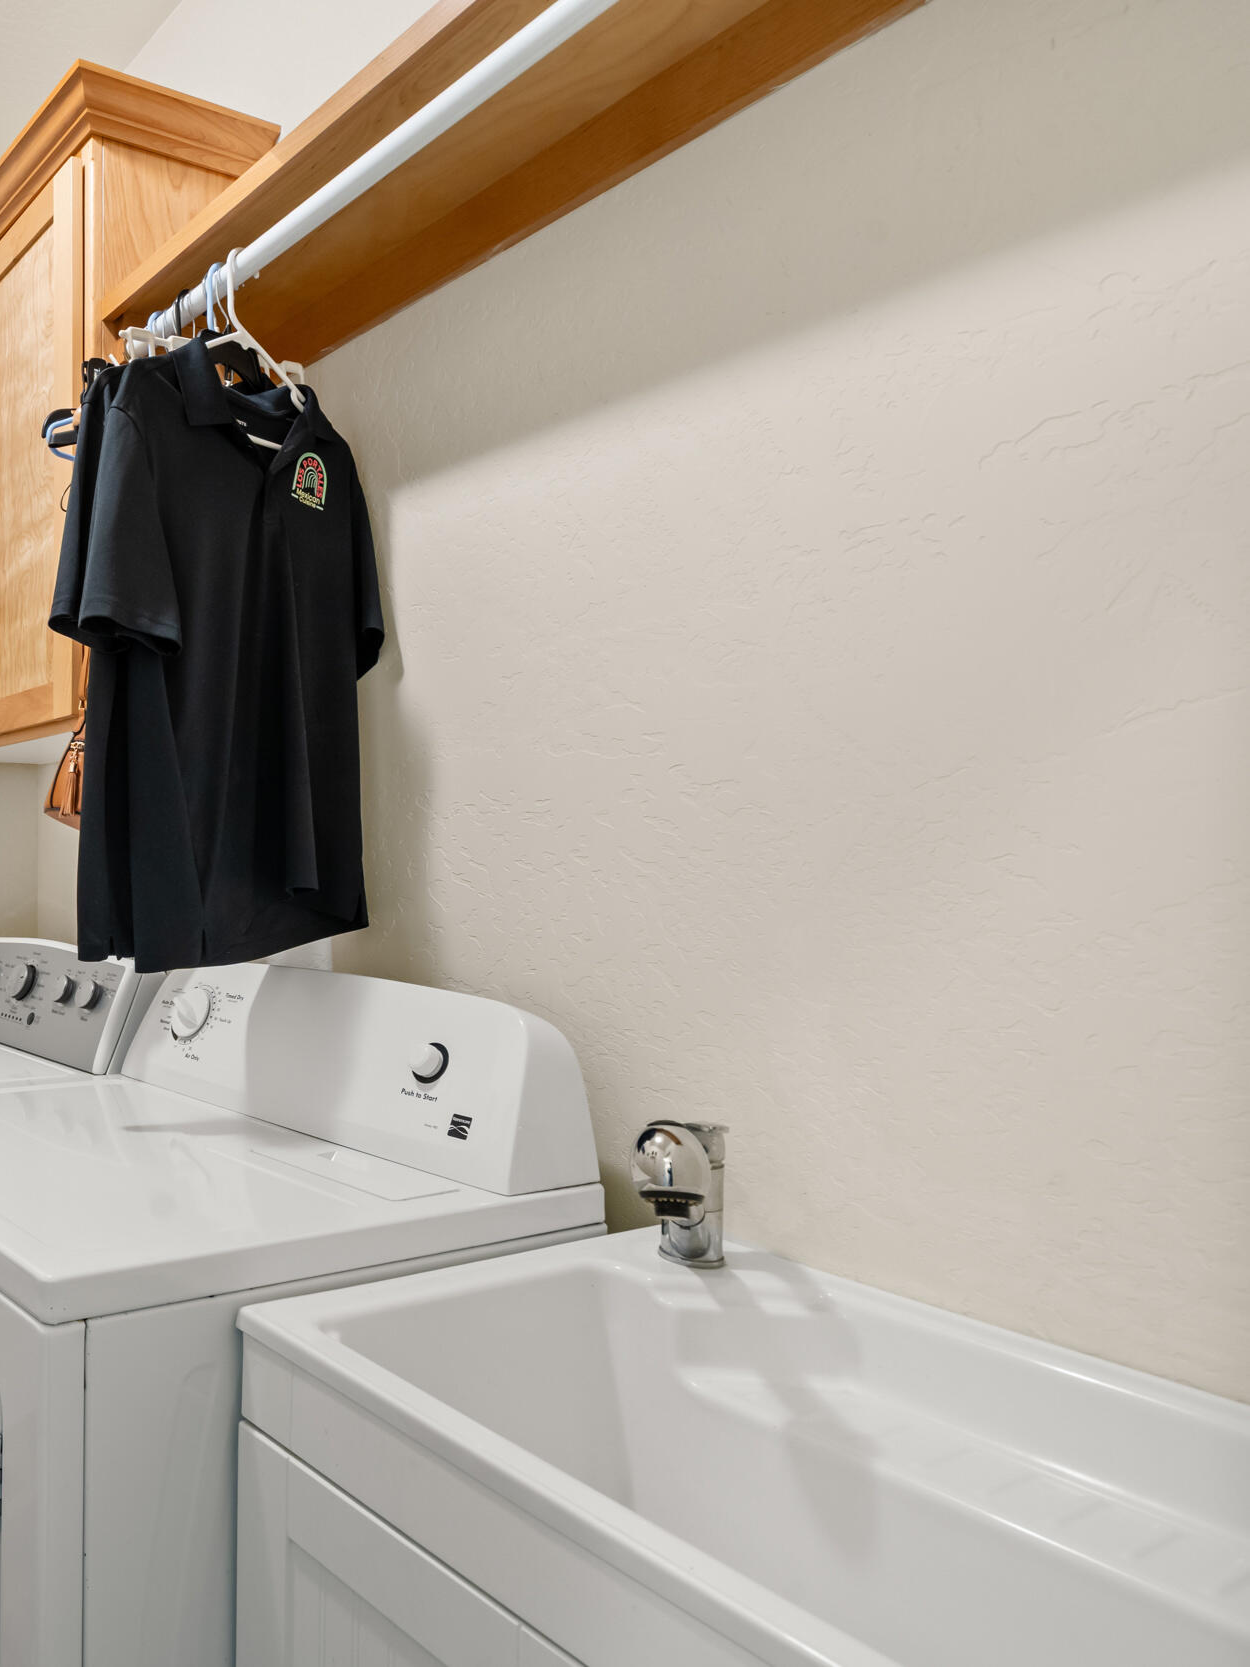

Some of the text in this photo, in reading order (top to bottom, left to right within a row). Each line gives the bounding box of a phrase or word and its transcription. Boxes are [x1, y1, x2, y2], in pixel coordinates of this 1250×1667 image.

[296, 457, 324, 498] LOS PORTALES
[400, 1088, 415, 1097] Push
[422, 1093, 438, 1103] Start
